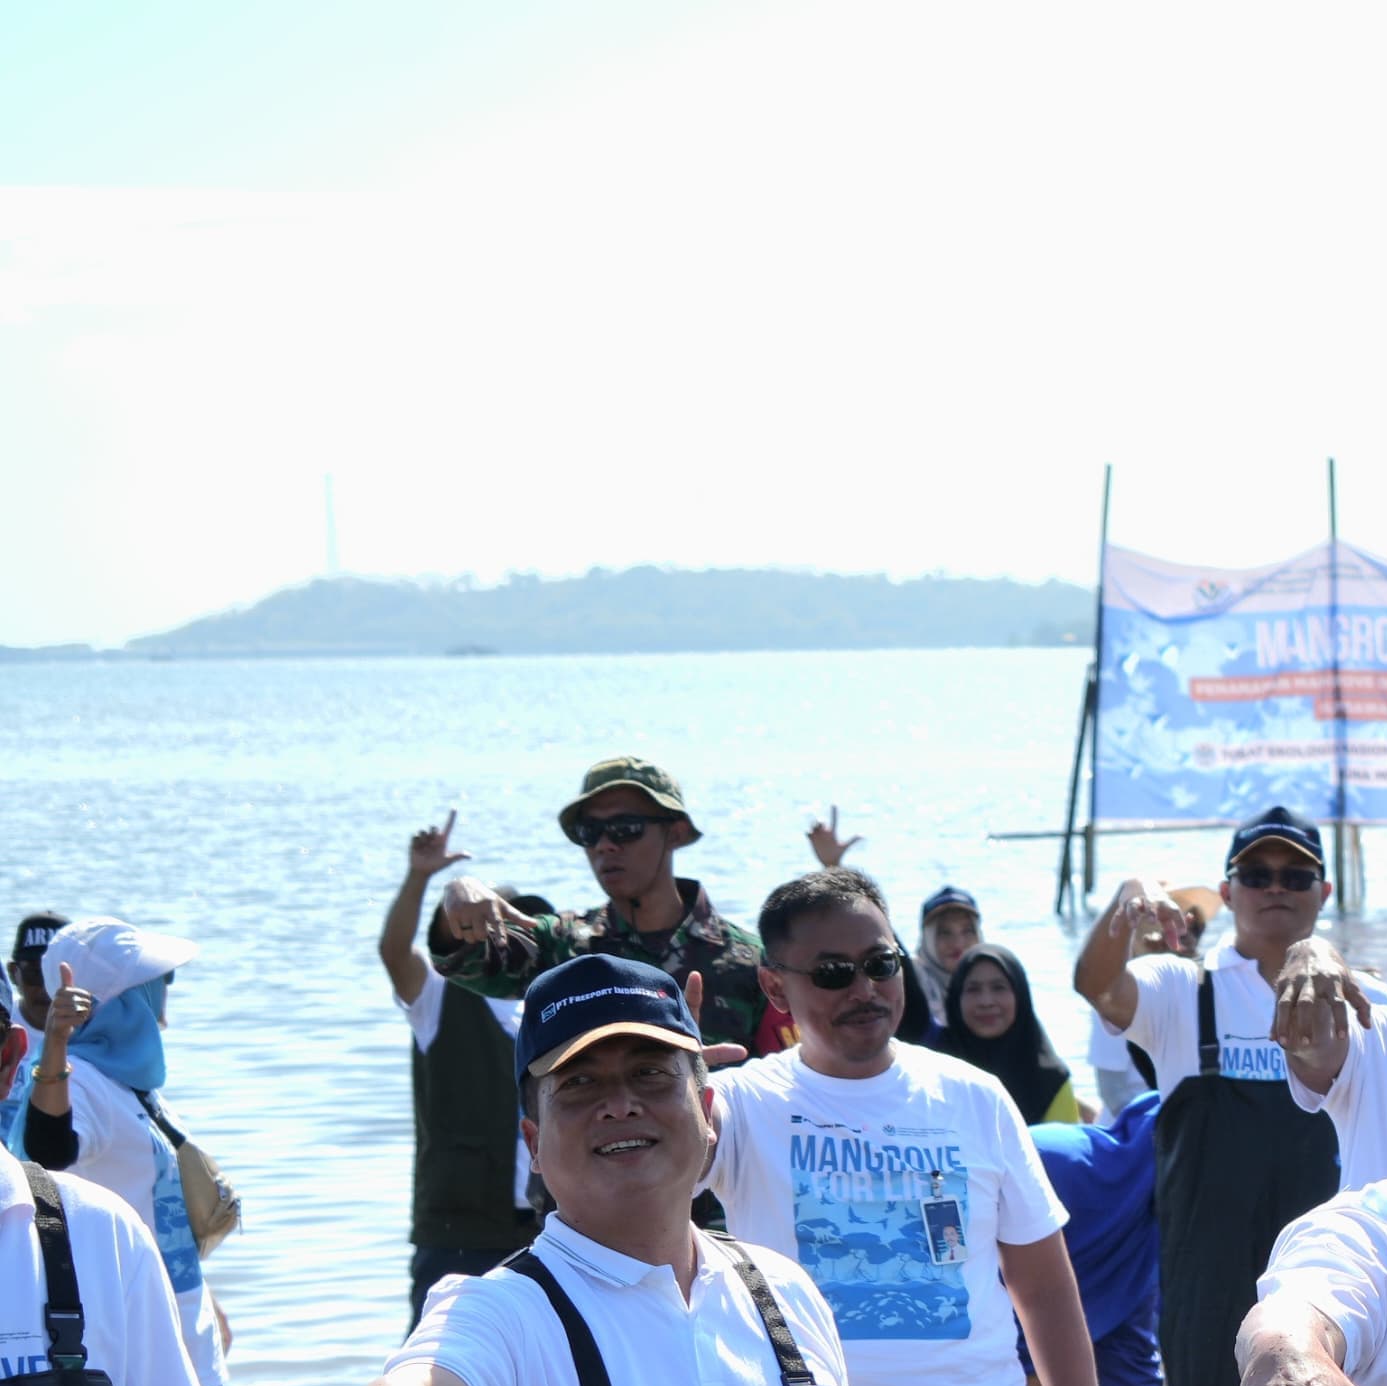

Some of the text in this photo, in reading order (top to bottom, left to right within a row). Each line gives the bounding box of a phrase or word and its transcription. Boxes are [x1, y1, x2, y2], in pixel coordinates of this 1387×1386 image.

[556, 998, 568, 1011] PT
[569, 986, 613, 1005] FREEPORT
[1222, 1047, 1282, 1072] MANG
[790, 1134, 962, 1174] MANGROVE
[813, 1171, 928, 1201] FOR LIF
